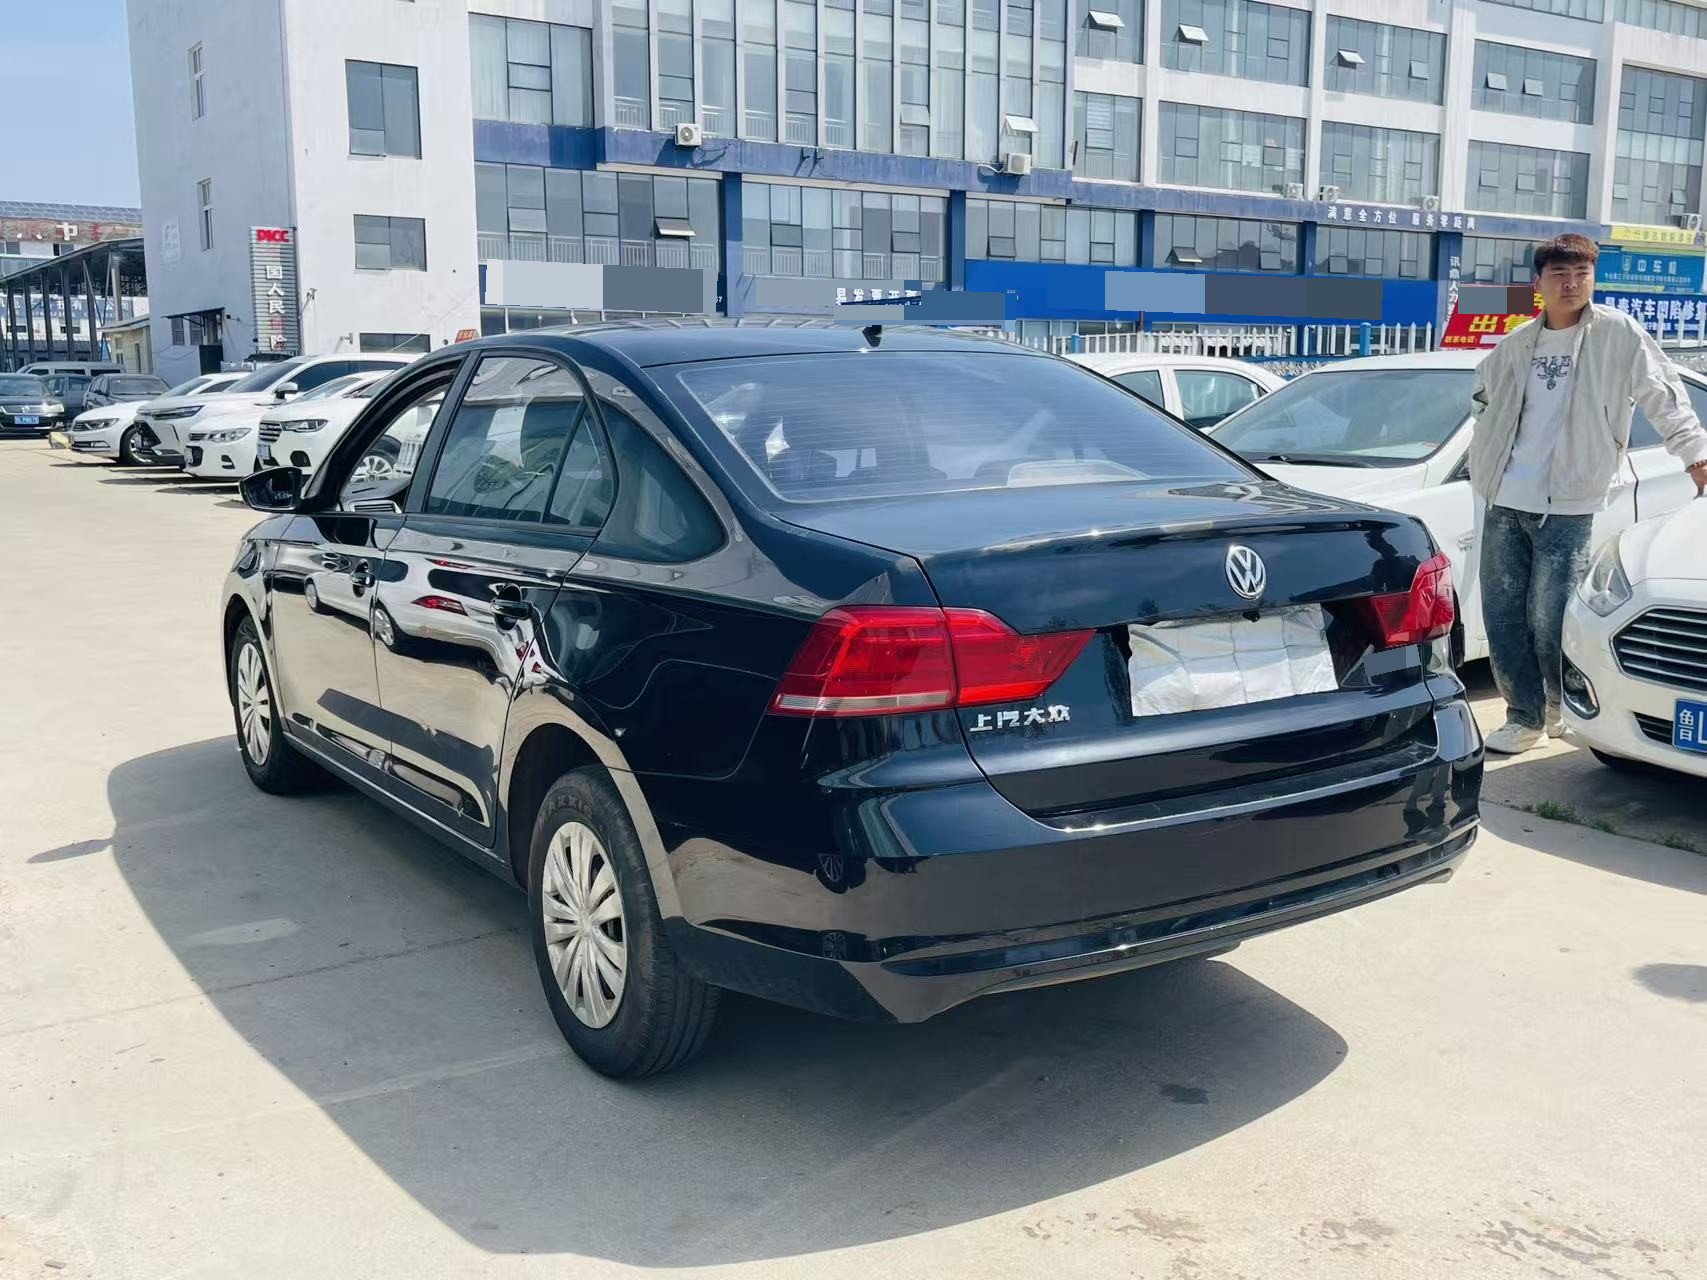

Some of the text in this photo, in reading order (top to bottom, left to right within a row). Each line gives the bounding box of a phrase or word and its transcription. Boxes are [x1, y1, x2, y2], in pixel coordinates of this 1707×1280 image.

[1327, 205, 1475, 230] 满意全方位 服务零距离
[969, 704, 1071, 732] 上汽大众
